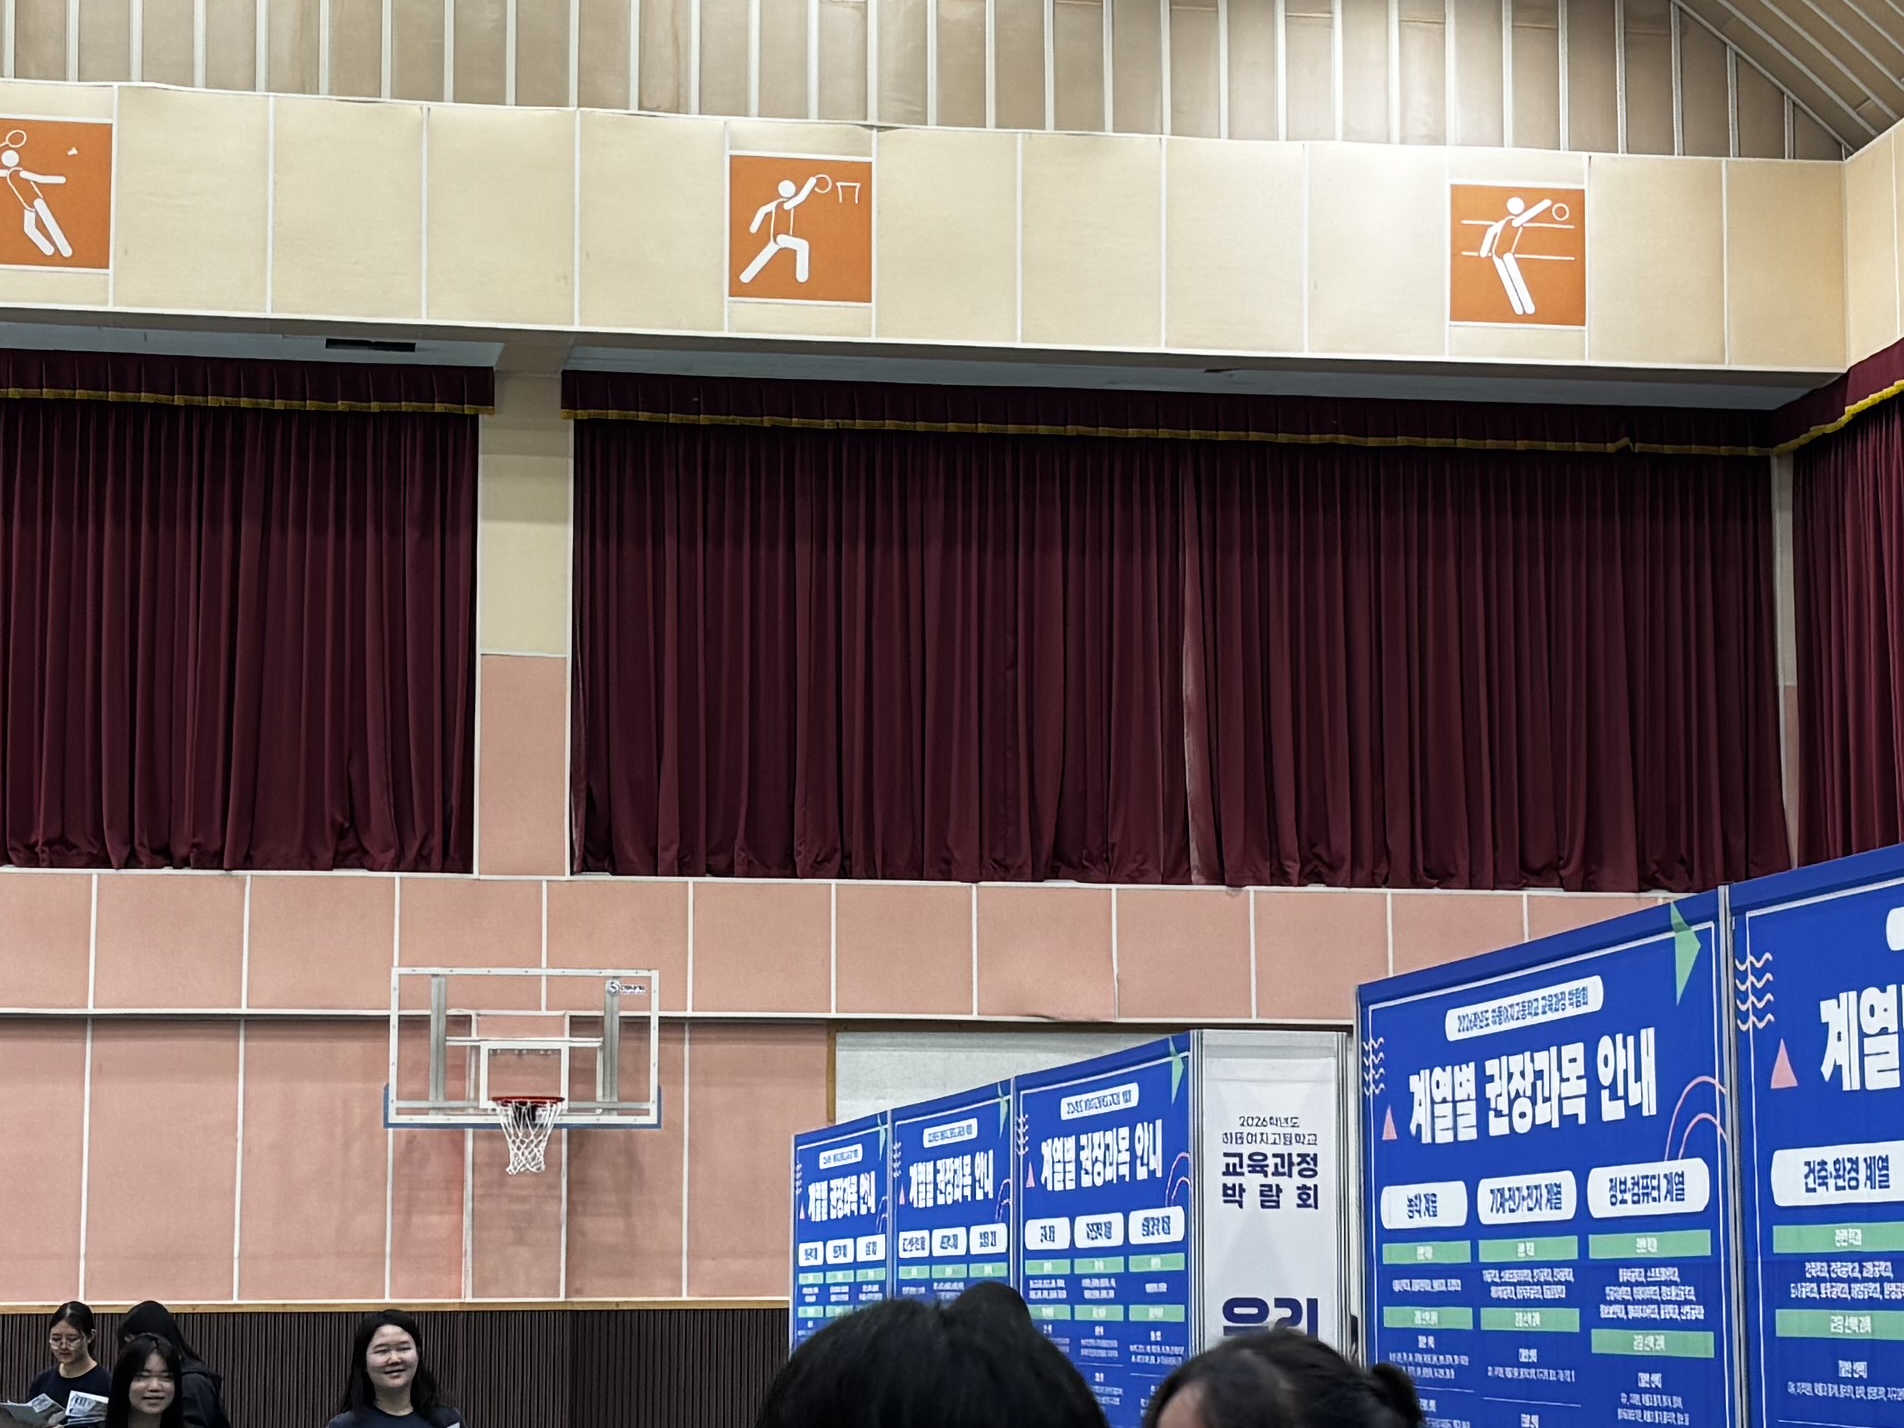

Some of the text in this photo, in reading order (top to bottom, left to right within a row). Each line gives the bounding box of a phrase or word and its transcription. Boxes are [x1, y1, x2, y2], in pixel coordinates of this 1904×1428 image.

[1408, 1027, 1657, 1144] 계열별 권장과목 안내
[1041, 1119, 1162, 1191] 계열별 권장과목 안내
[1222, 1151, 1318, 1178] 교육과정
[1863, 1154, 1890, 1190] 계열
